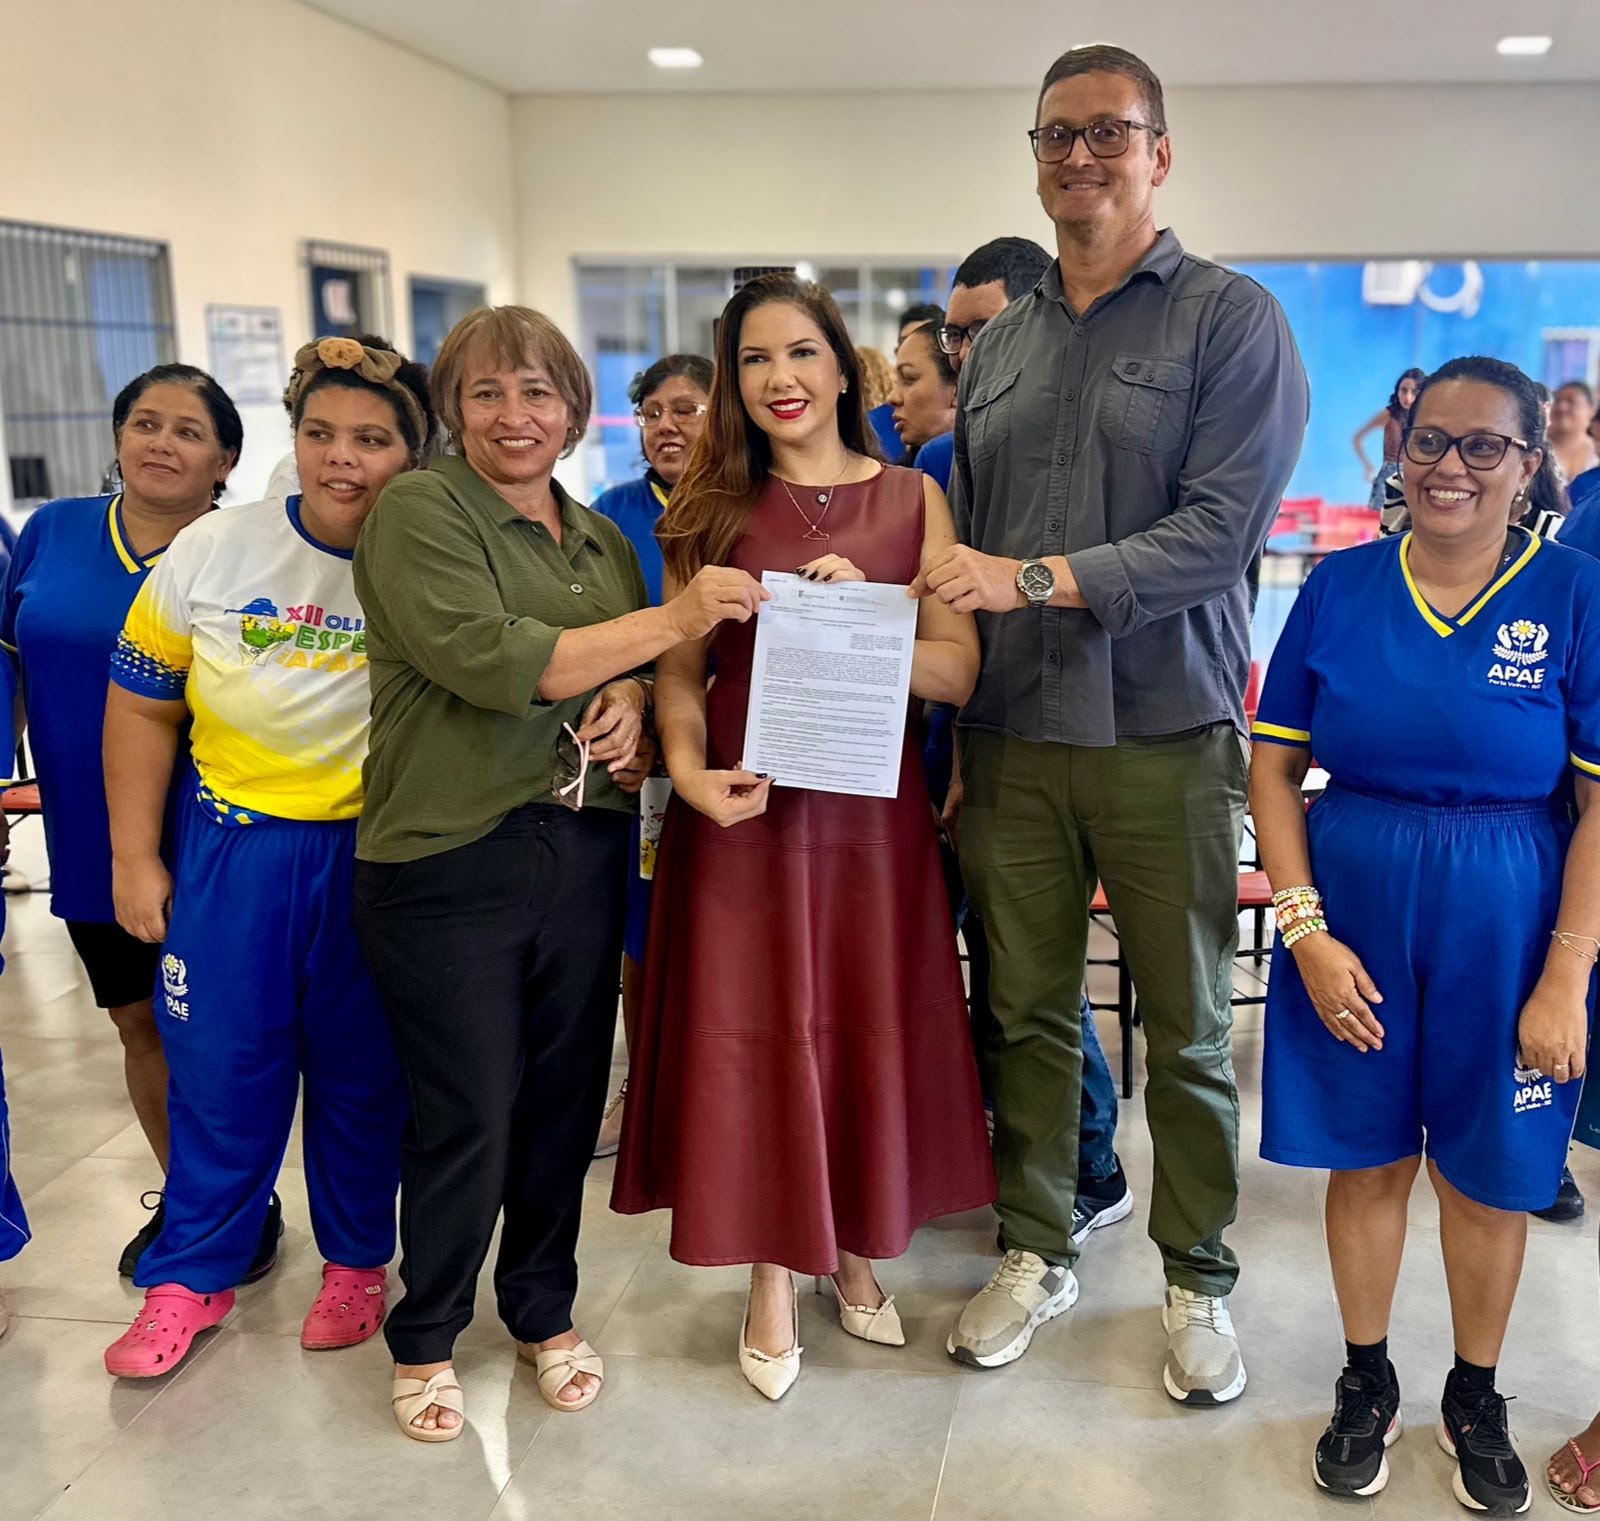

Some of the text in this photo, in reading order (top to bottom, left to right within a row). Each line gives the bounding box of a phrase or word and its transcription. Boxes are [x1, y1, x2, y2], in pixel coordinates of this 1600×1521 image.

[285, 605, 365, 631] XII OLI
[1487, 664, 1545, 684] APAE
[164, 993, 189, 1016] PAE
[1514, 1082, 1552, 1107] APAE
